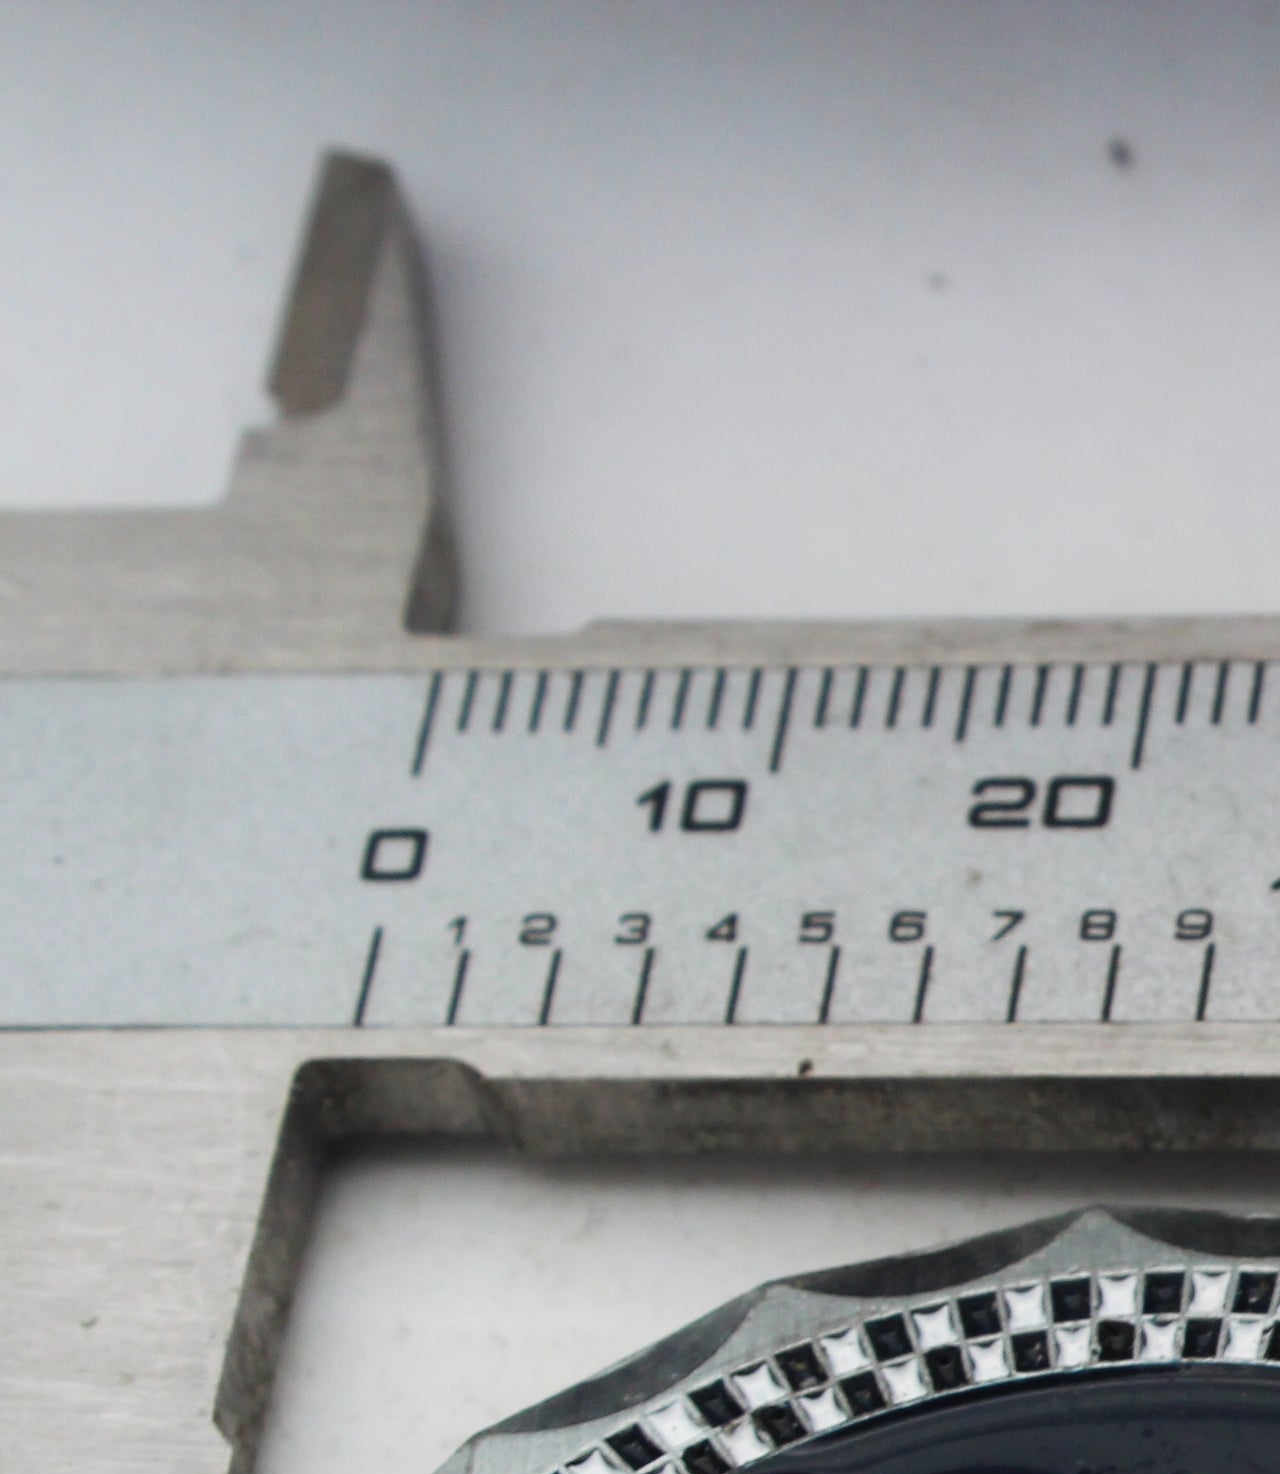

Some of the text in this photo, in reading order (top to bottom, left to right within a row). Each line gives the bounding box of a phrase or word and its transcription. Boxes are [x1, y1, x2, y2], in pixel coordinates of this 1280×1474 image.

[360, 828, 430, 883] 0
[637, 779, 749, 834] 10
[967, 775, 1116, 830] 20
[446, 916, 469, 945] 1
[519, 913, 557, 946] 2
[615, 913, 652, 946] 3
[705, 912, 740, 944] 4
[798, 911, 835, 944] 5
[888, 910, 927, 943] 6
[992, 909, 1026, 942] 7
[1079, 909, 1117, 942] 8
[1174, 909, 1214, 942] 9
